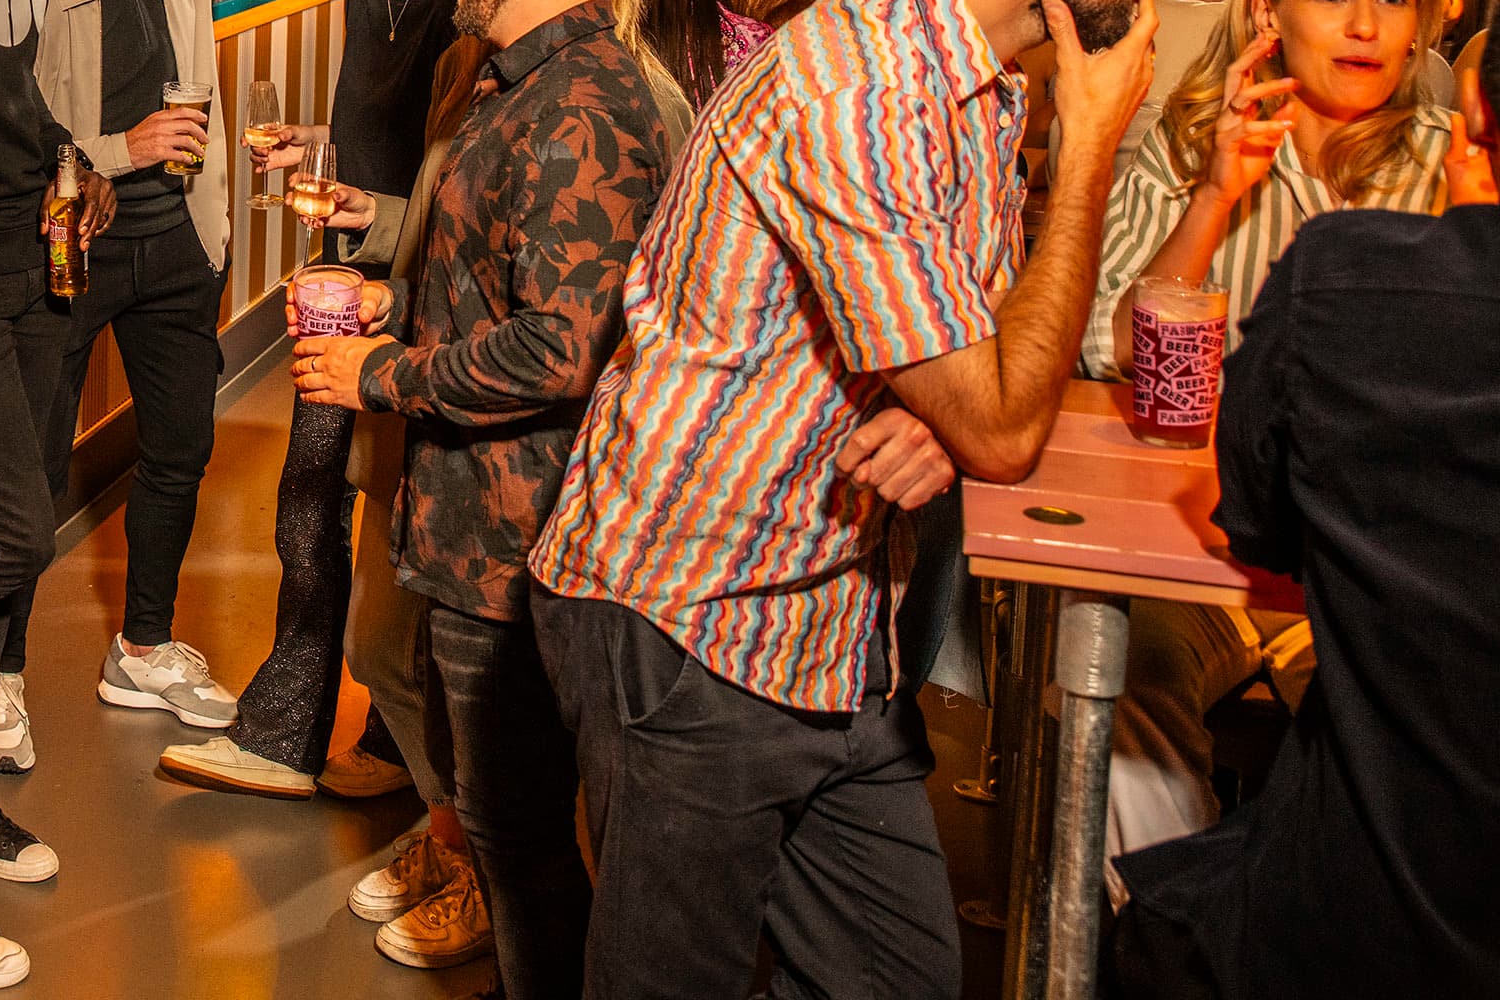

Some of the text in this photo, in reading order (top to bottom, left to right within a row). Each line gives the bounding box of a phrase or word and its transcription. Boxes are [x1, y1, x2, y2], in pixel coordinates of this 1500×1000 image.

[304, 307, 355, 321] FAIRGAME
[309, 322, 334, 331] BEER
[1166, 341, 1199, 354] BEER
[1176, 377, 1206, 390] BEER
[1160, 386, 1190, 408] BEER
